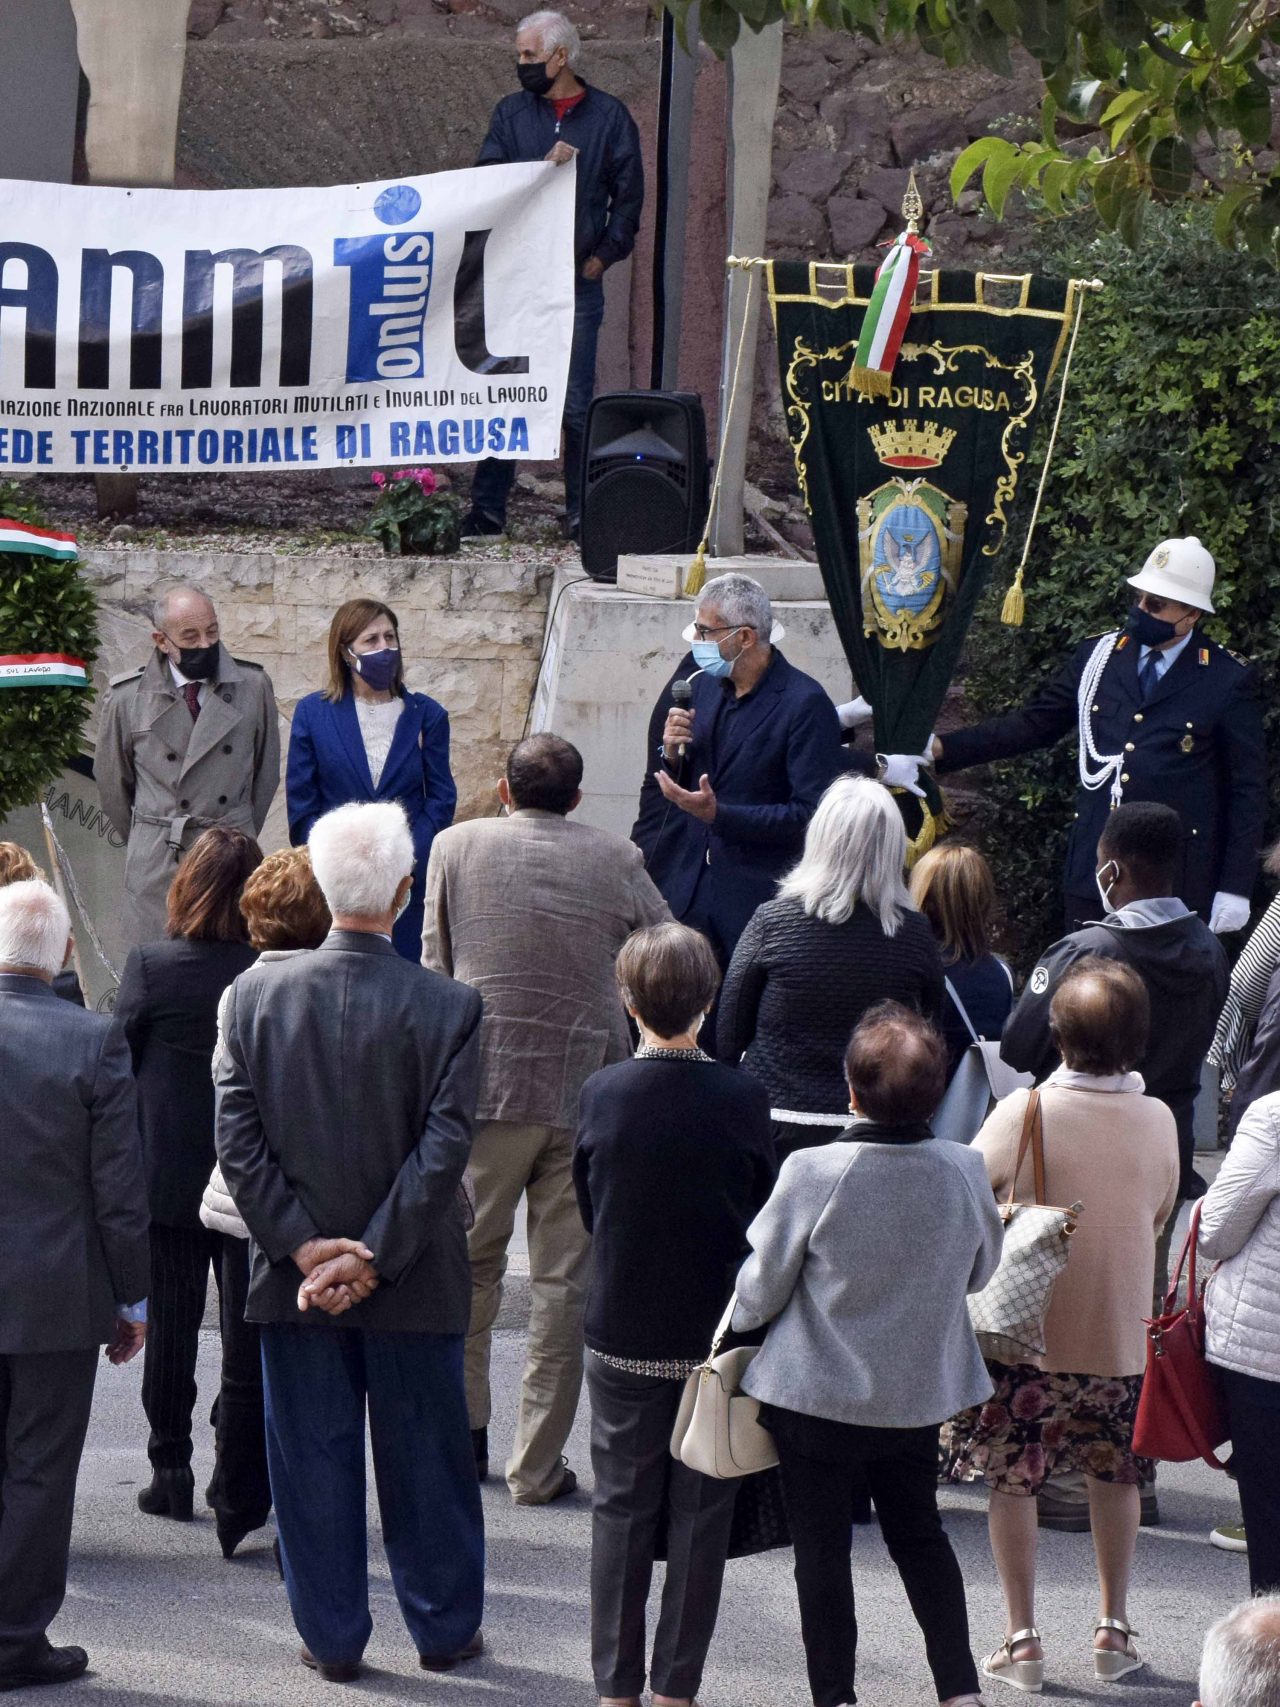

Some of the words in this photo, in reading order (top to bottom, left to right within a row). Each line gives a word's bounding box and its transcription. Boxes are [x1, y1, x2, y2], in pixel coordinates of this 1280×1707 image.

[369, 235, 431, 377] onlus
[888, 387, 909, 408] DI
[919, 386, 1010, 412] RAGUSA
[70, 425, 318, 465] TERRITORIALE
[336, 423, 371, 459] DI
[390, 417, 529, 457] RAGUSA
